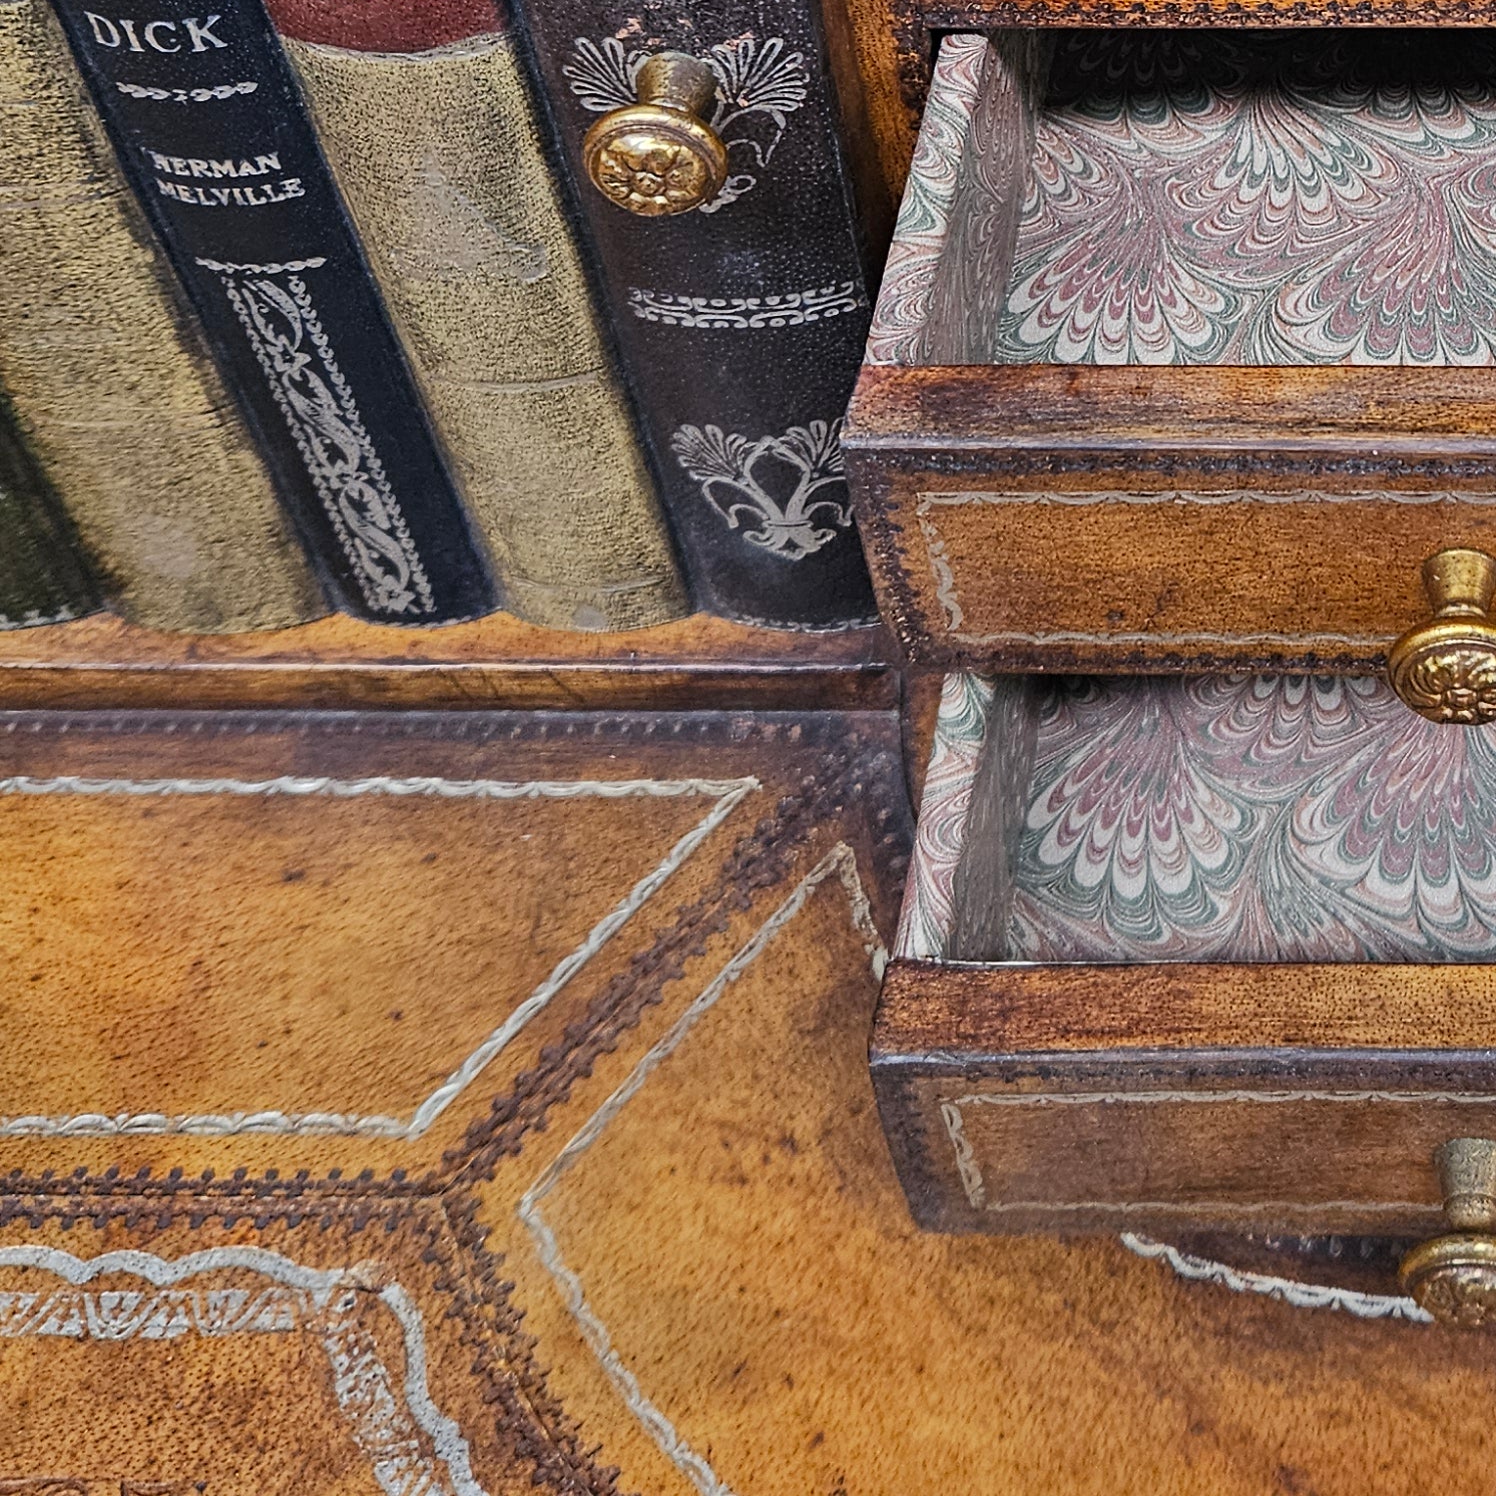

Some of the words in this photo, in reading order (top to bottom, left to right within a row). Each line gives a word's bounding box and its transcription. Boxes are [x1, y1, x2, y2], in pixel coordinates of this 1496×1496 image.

[83, 10, 229, 53] DICK
[139, 146, 282, 179] HERMAN
[153, 177, 306, 206] MELVILLE
